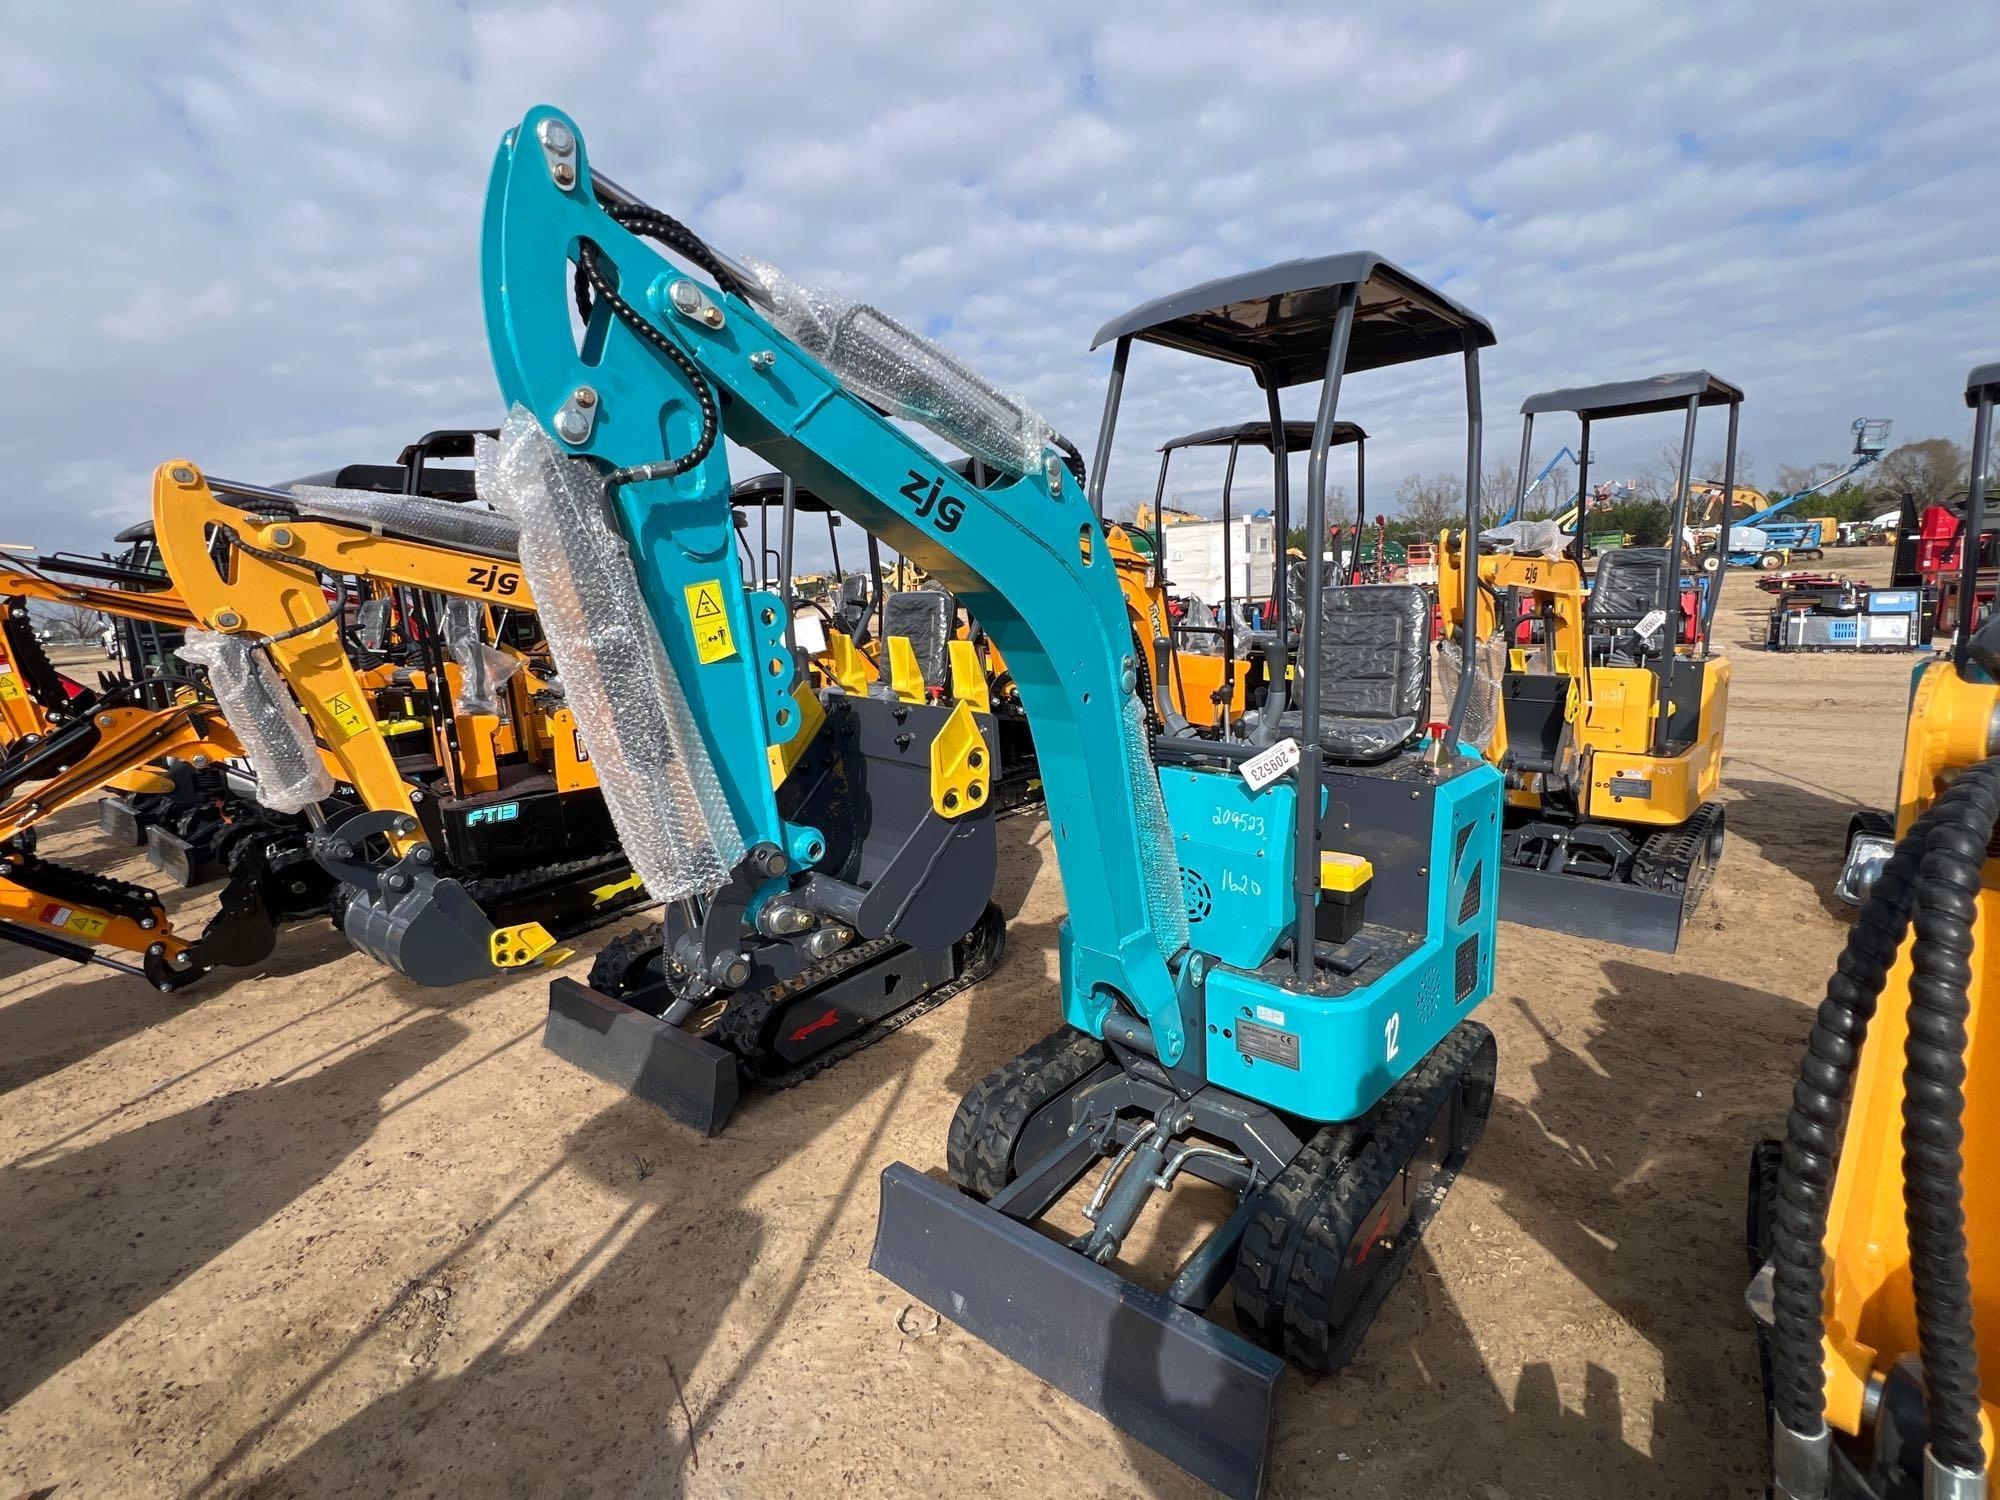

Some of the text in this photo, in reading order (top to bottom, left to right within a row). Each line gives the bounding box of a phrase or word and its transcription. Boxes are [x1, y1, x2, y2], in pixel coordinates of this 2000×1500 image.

[899, 468, 967, 533] zjg
[467, 564, 520, 595] zjg
[1525, 562, 1538, 584] zjg
[1251, 751, 1289, 781] 209523
[1212, 806, 1265, 836] 209523
[1222, 868, 1261, 896] 1620
[1384, 1011, 1400, 1062] 12
